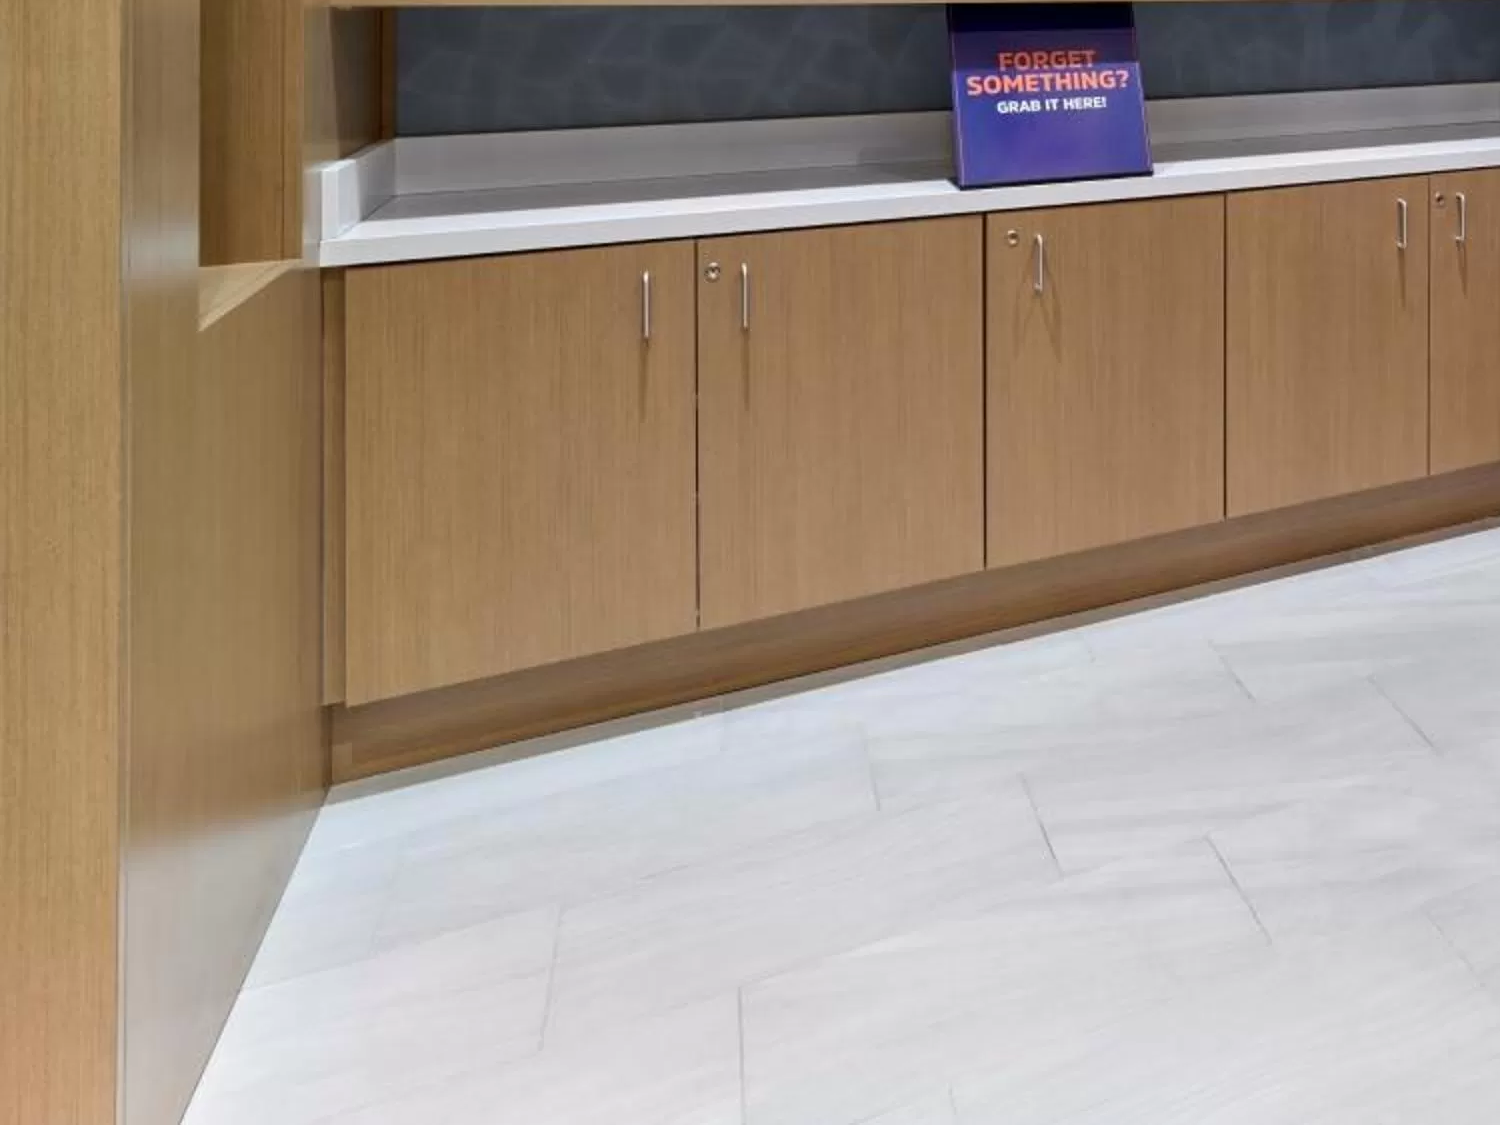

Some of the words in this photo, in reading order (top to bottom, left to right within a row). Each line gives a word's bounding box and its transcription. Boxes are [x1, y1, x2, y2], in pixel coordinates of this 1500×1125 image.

[998, 48, 1097, 72] FORGET
[966, 70, 1130, 97] SOMETHING?
[996, 99, 1042, 114] GRAB
[1045, 98, 1060, 112] IT
[1063, 96, 1108, 111] HERE!
